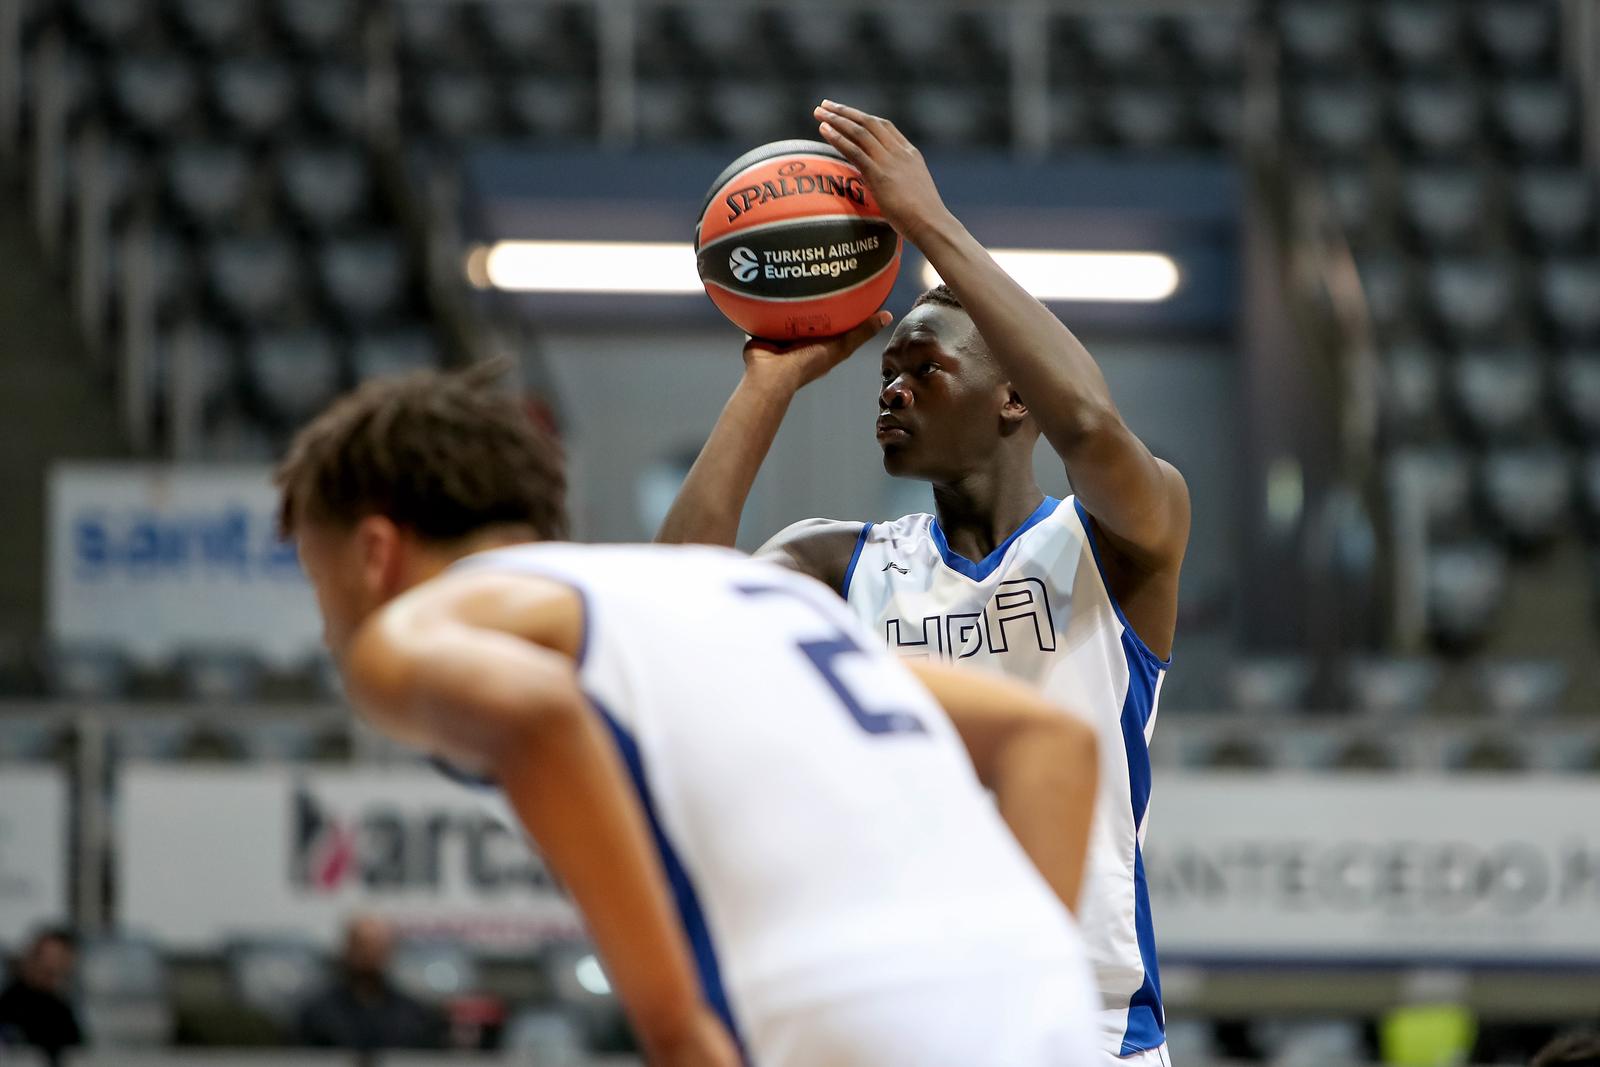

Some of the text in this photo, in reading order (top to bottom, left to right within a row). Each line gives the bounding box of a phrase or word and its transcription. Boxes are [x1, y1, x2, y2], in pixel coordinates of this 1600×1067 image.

[725, 175, 867, 224] SPALDING
[763, 236, 879, 264] TURKISH AIRLINES
[764, 258, 858, 279] EuroLeague
